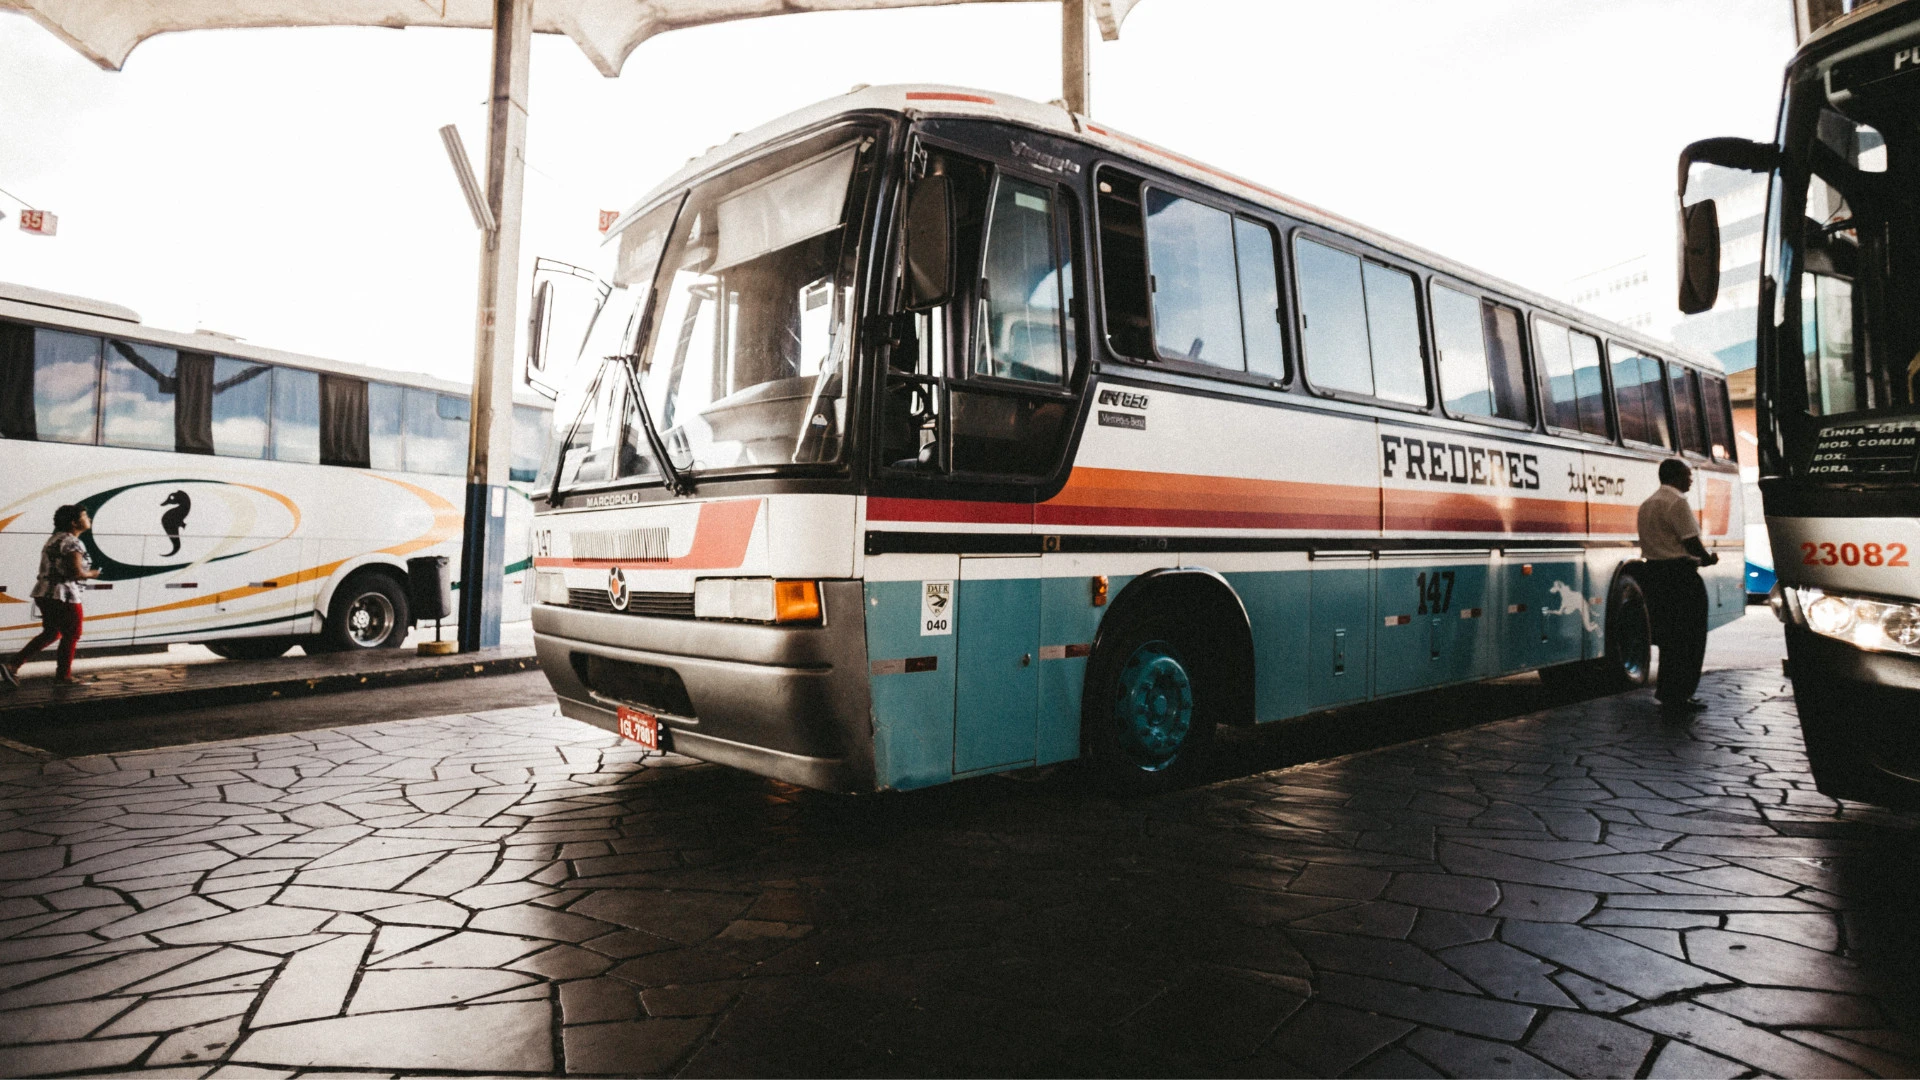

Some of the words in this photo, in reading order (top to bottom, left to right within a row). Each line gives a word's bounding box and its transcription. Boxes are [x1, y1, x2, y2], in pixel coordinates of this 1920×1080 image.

[21, 212, 42, 228] 35
[1820, 427, 1865, 438] LINHA
[1818, 441, 1853, 449] MOD.
[1857, 437, 1916, 447] COMUM
[1568, 463, 1626, 496] turismo
[586, 492, 640, 508] MARCOPOLO
[535, 530, 552, 557] 147
[1800, 542, 1910, 567] 23082
[1416, 571, 1455, 615] 147
[926, 620, 947, 631] 040
